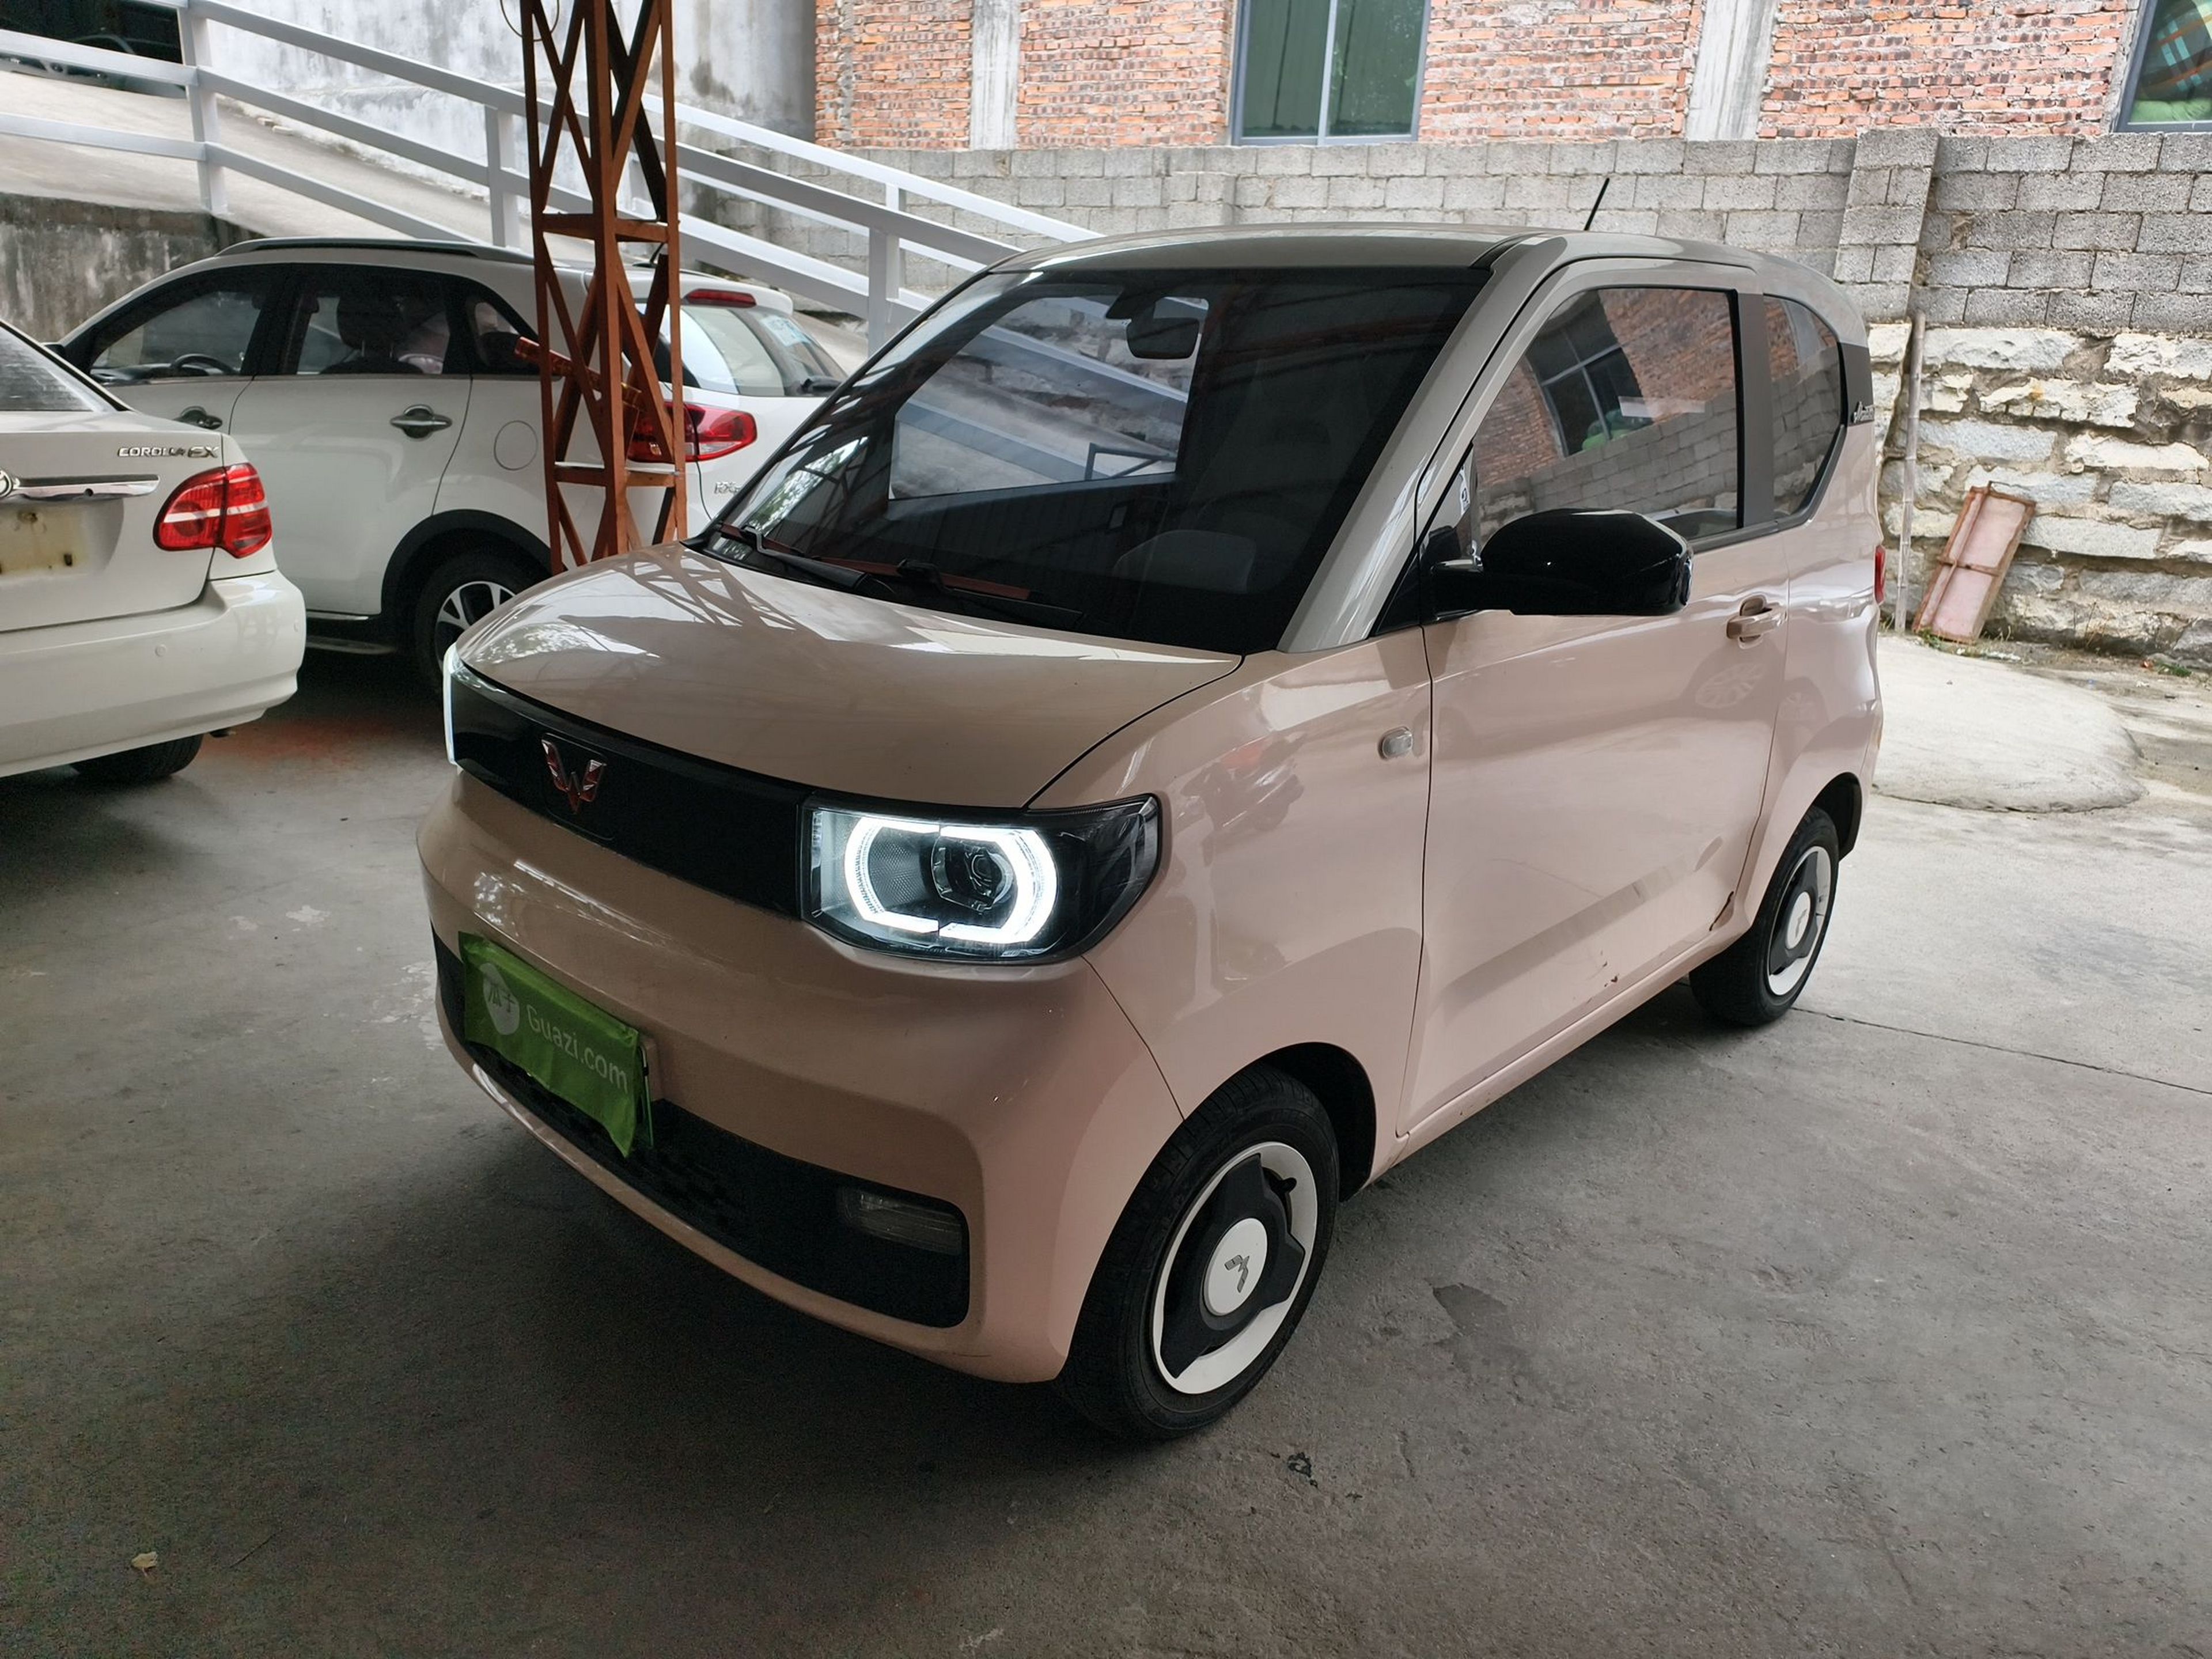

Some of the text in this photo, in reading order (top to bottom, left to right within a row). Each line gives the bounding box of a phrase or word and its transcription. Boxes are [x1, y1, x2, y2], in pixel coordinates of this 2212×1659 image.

[187, 445, 219, 458] EX
[488, 981, 516, 1013] 瓜子
[527, 1004, 628, 1094] Guazi.com
